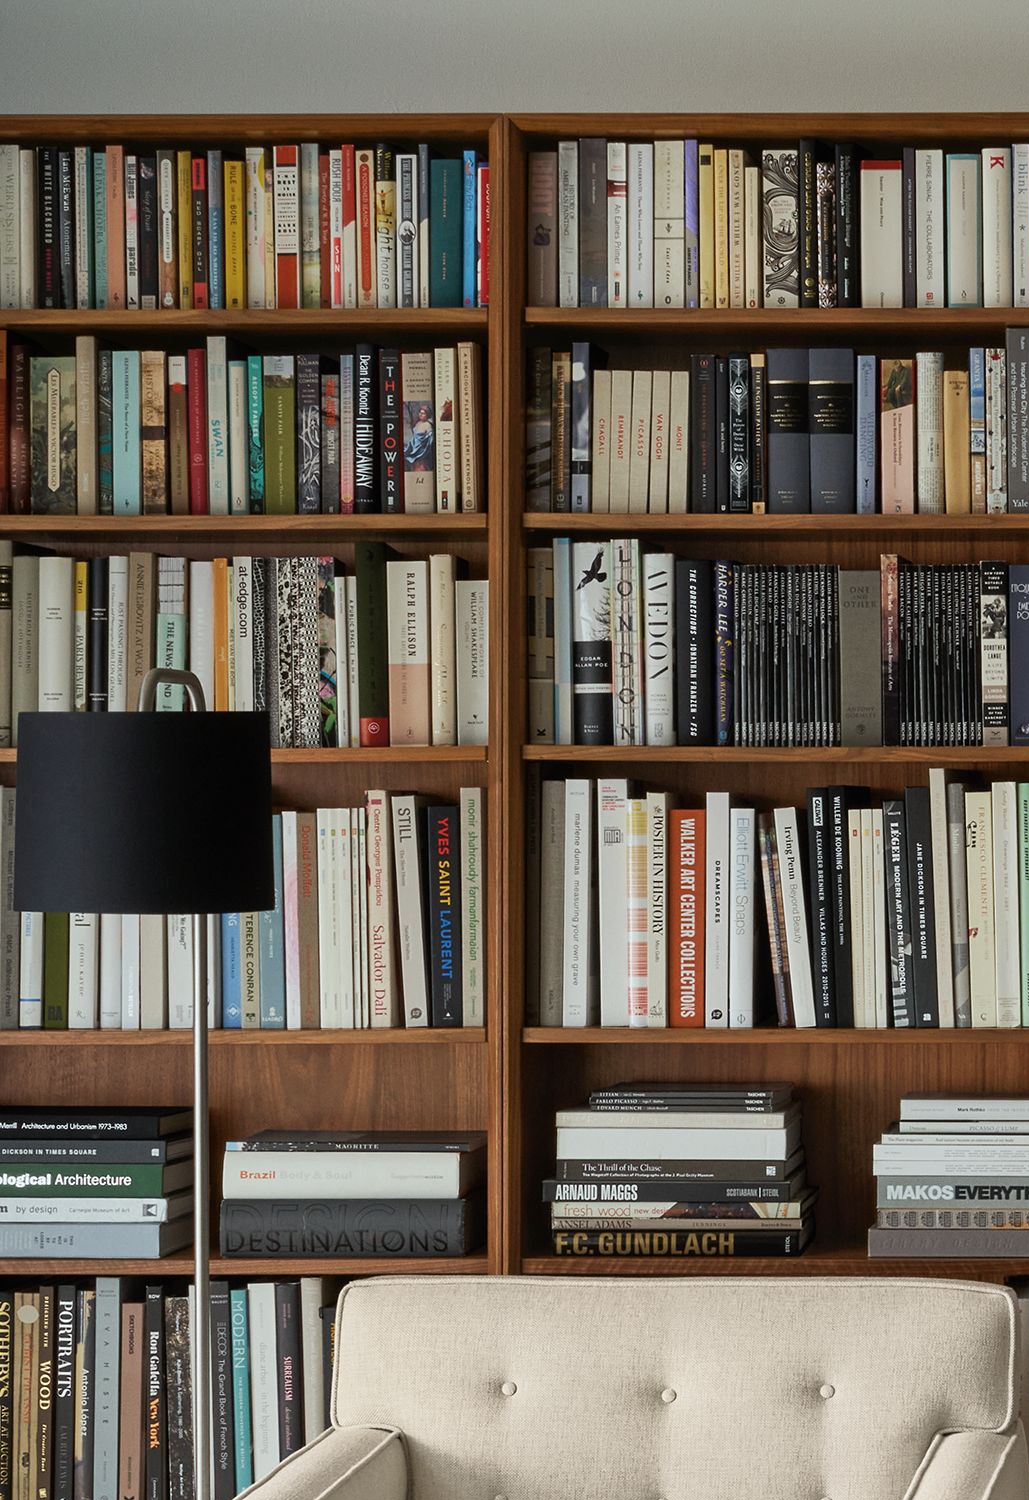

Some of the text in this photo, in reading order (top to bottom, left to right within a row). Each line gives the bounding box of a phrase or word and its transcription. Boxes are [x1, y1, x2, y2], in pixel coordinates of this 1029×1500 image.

[63, 175, 71, 211] McEwan
[1018, 163, 1029, 194] blink
[63, 220, 71, 265] Atonement
[359, 355, 370, 375] Dean
[385, 366, 395, 406] THE
[359, 388, 370, 415] Koontz
[356, 424, 373, 489] HIDEAWAY
[385, 423, 397, 491] POWER
[237, 566, 248, 638] at-edge.com
[406, 573, 416, 657] RALPH ELLISON
[718, 565, 727, 632] HARPER LEE
[398, 808, 411, 843] STILL
[833, 796, 843, 870] WILLEM DE KOONING
[890, 822, 902, 862] LÉGER
[653, 816, 663, 935] POSTER IN HISTORY
[784, 826, 796, 879] Irving Penn
[438, 818, 452, 978] YVES SAINT LAURENT
[893, 866, 902, 898] MODERN
[680, 818, 695, 1017] WALKER ART CENTER COLLECTIONS
[896, 914, 904, 930] AND
[246, 915, 254, 1001] TERENCE CONRAN
[373, 925, 387, 1016] Salvador Dalí
[898, 946, 907, 994] METROPOLIS
[55, 1174, 131, 1186] Architecture
[240, 1171, 276, 1179] Brazil
[555, 1185, 638, 1200] ARNAUD MAGGS
[226, 1230, 448, 1252] DESTINATIONS
[555, 1232, 735, 1255] F.C. GUNDLACH
[58, 1301, 72, 1398] PORTRAITS
[231, 1301, 245, 1368] MODERN
[39, 1361, 51, 1410] WOOD
[149, 1332, 160, 1448] Ron Galella New York
